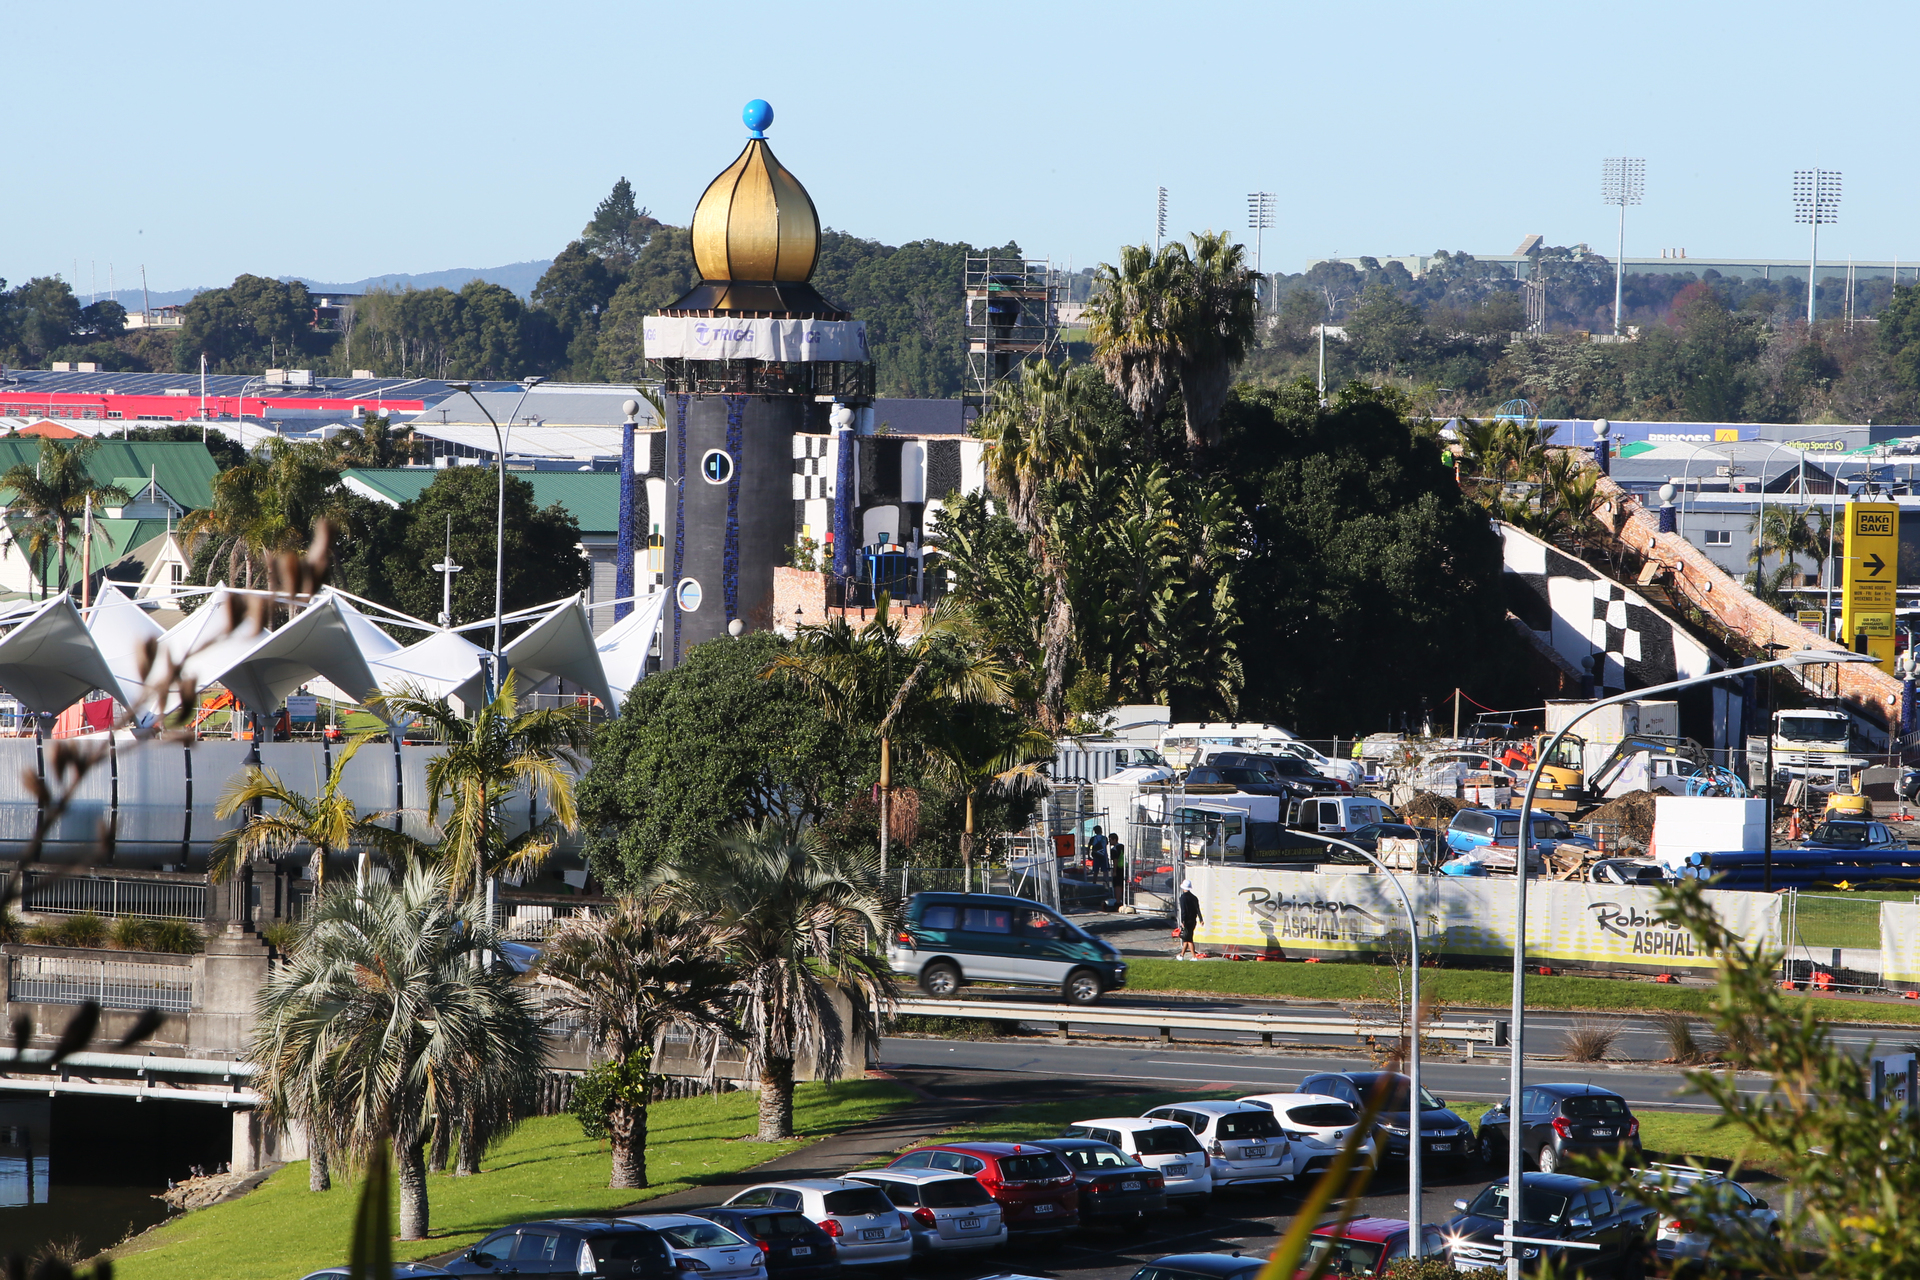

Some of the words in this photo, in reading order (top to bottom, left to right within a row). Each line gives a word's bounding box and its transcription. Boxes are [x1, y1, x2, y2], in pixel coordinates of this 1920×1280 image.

[713, 328, 755, 342] TRIGG
[1810, 441, 1834, 451] Sports
[1860, 524, 1889, 532] SAVE
[1238, 886, 1385, 923] Robinson
[1281, 916, 1359, 941] ASPHALTS
